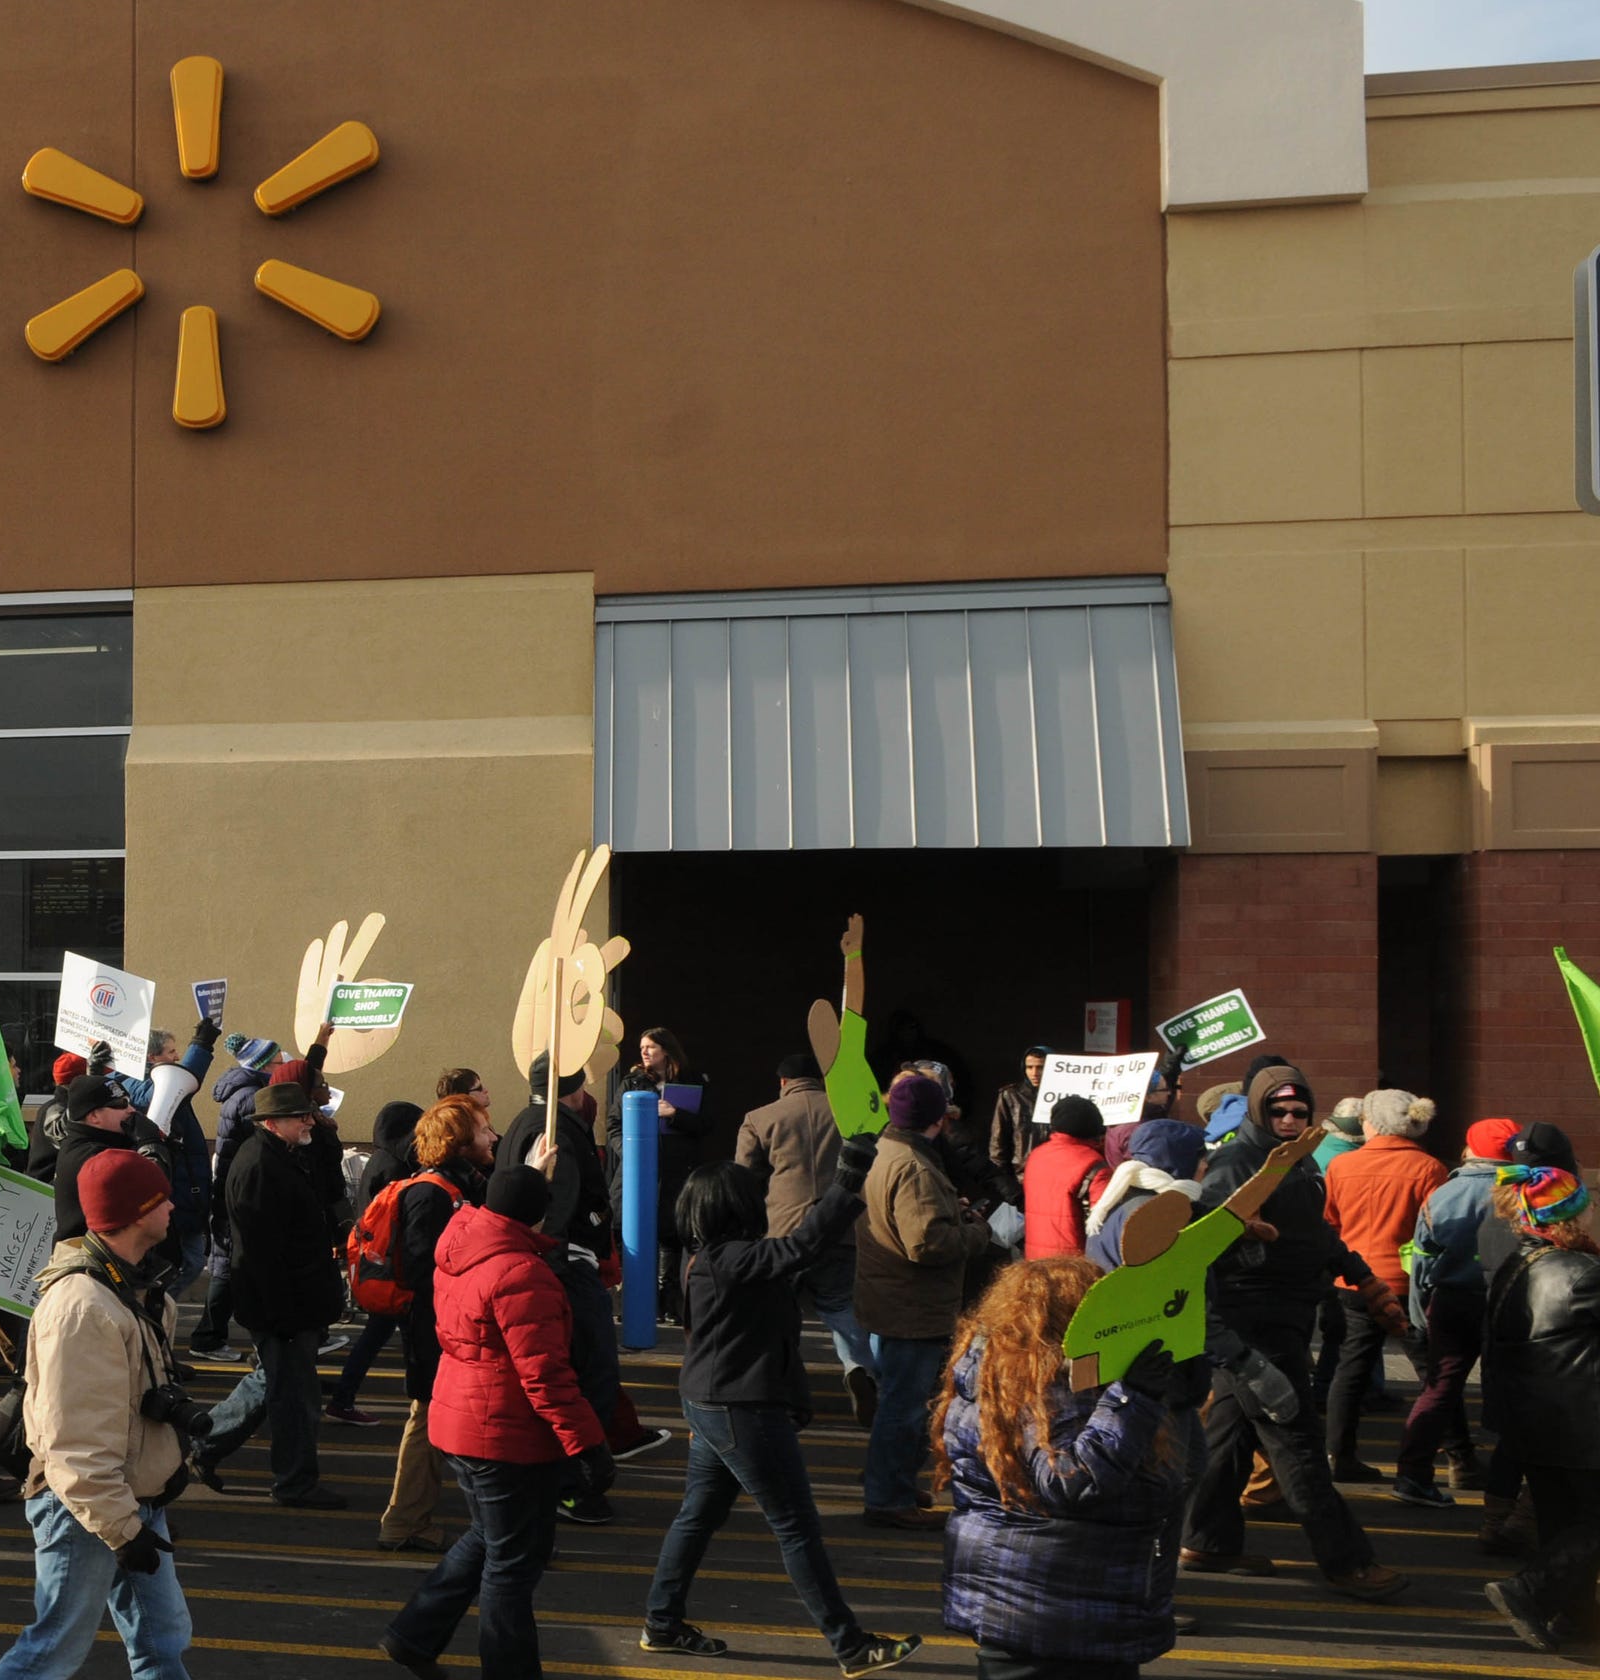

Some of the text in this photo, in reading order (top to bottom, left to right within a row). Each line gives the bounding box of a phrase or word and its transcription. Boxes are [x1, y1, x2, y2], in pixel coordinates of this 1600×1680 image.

[337, 988, 404, 999] GIVE THANKS
[354, 1001, 380, 1011] SHOP
[332, 1014, 395, 1024] RESPONSIBLY
[1168, 999, 1241, 1038] GIVE THANKS
[60, 1008, 79, 1020] UNITED
[81, 1015, 128, 1038] TRANSPORTATION
[128, 1031, 146, 1046] UNION
[1196, 1021, 1225, 1040] SHOP
[60, 1017, 89, 1033] MINNESOTA
[124, 1041, 145, 1055] BOARD
[1184, 1026, 1253, 1062] RESPONSIBLY
[1129, 1060, 1146, 1073] Up
[1091, 1078, 1114, 1091] for
[868, 1649, 884, 1663] N
